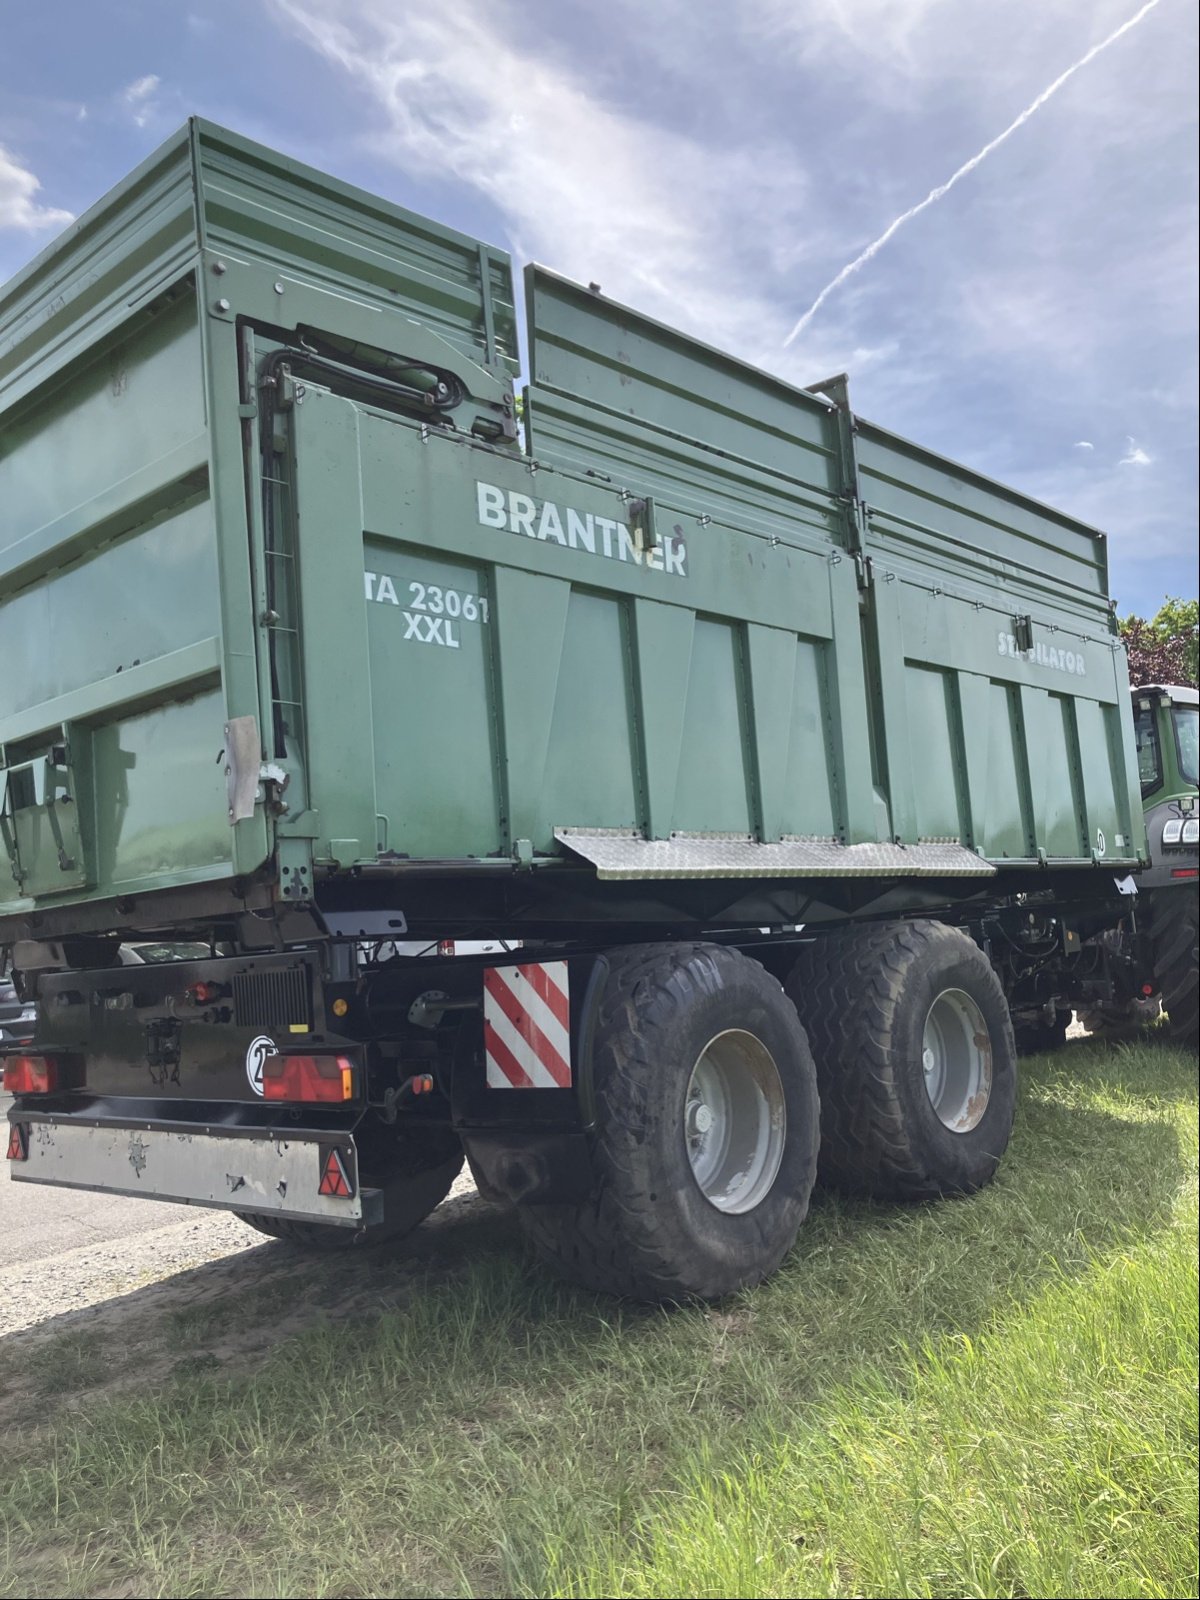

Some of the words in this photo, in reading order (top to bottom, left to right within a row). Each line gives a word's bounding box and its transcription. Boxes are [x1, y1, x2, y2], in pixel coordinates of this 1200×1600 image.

[477, 481, 686, 576] BRANTNER
[364, 571, 399, 605] TA
[409, 582, 489, 623] 23061
[402, 612, 459, 648] XXL
[998, 632, 1086, 675] STBILATOR
